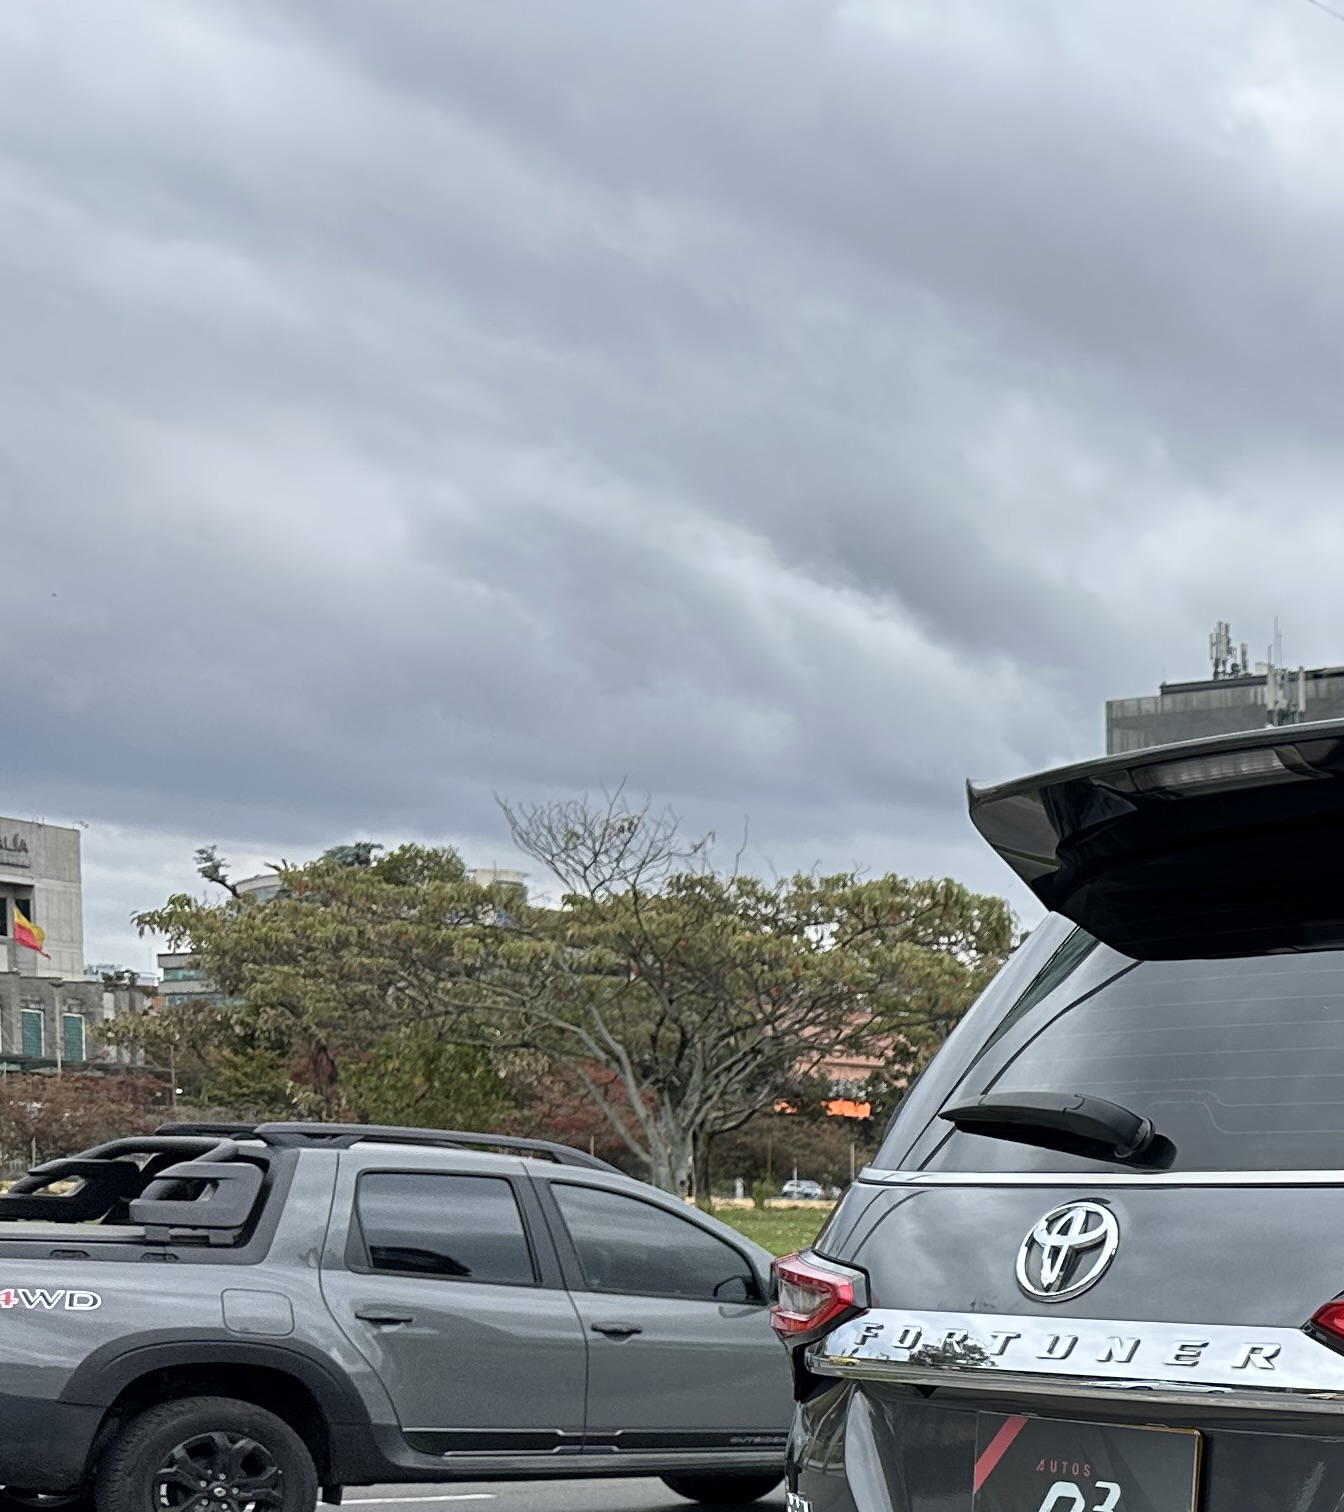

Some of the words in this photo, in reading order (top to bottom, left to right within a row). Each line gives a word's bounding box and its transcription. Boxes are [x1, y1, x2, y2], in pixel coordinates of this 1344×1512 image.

[0, 1287, 101, 1311] 4WD
[854, 1322, 1282, 1370] FORTUNER
[1036, 1459, 1091, 1477] AUTOS
